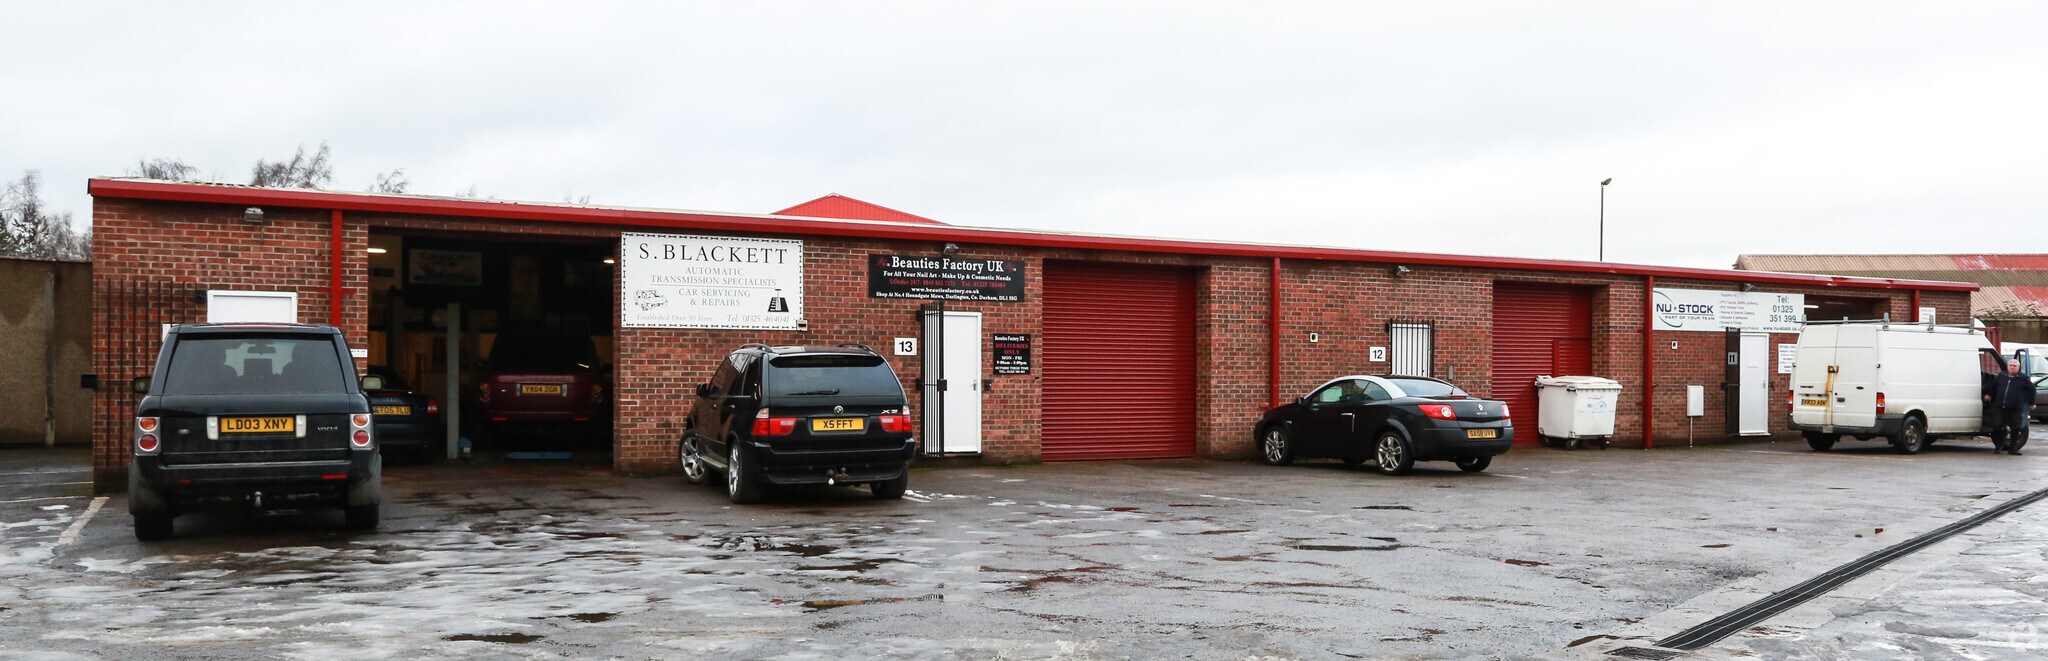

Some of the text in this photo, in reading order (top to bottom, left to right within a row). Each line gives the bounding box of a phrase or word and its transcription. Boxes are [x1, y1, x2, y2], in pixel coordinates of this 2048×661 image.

[891, 256, 1004, 274] Beauties Factory UK
[685, 267, 744, 276] AUTOMATIC
[651, 275, 777, 286] TRANSMISSION SPECIALISTS
[679, 288, 751, 297] CAR SERVICING
[702, 299, 741, 307] REPAIRS
[1777, 295, 1790, 303] Tel:
[1656, 303, 1714, 314] NU STOCK
[1772, 304, 1794, 313] 01325
[742, 315, 761, 323] 01325
[1769, 314, 1797, 323] 351 399
[899, 340, 913, 352] 13
[1373, 349, 1383, 359] 12
[227, 418, 288, 430] LD03 XNY
[823, 419, 854, 429] X5 FFT
